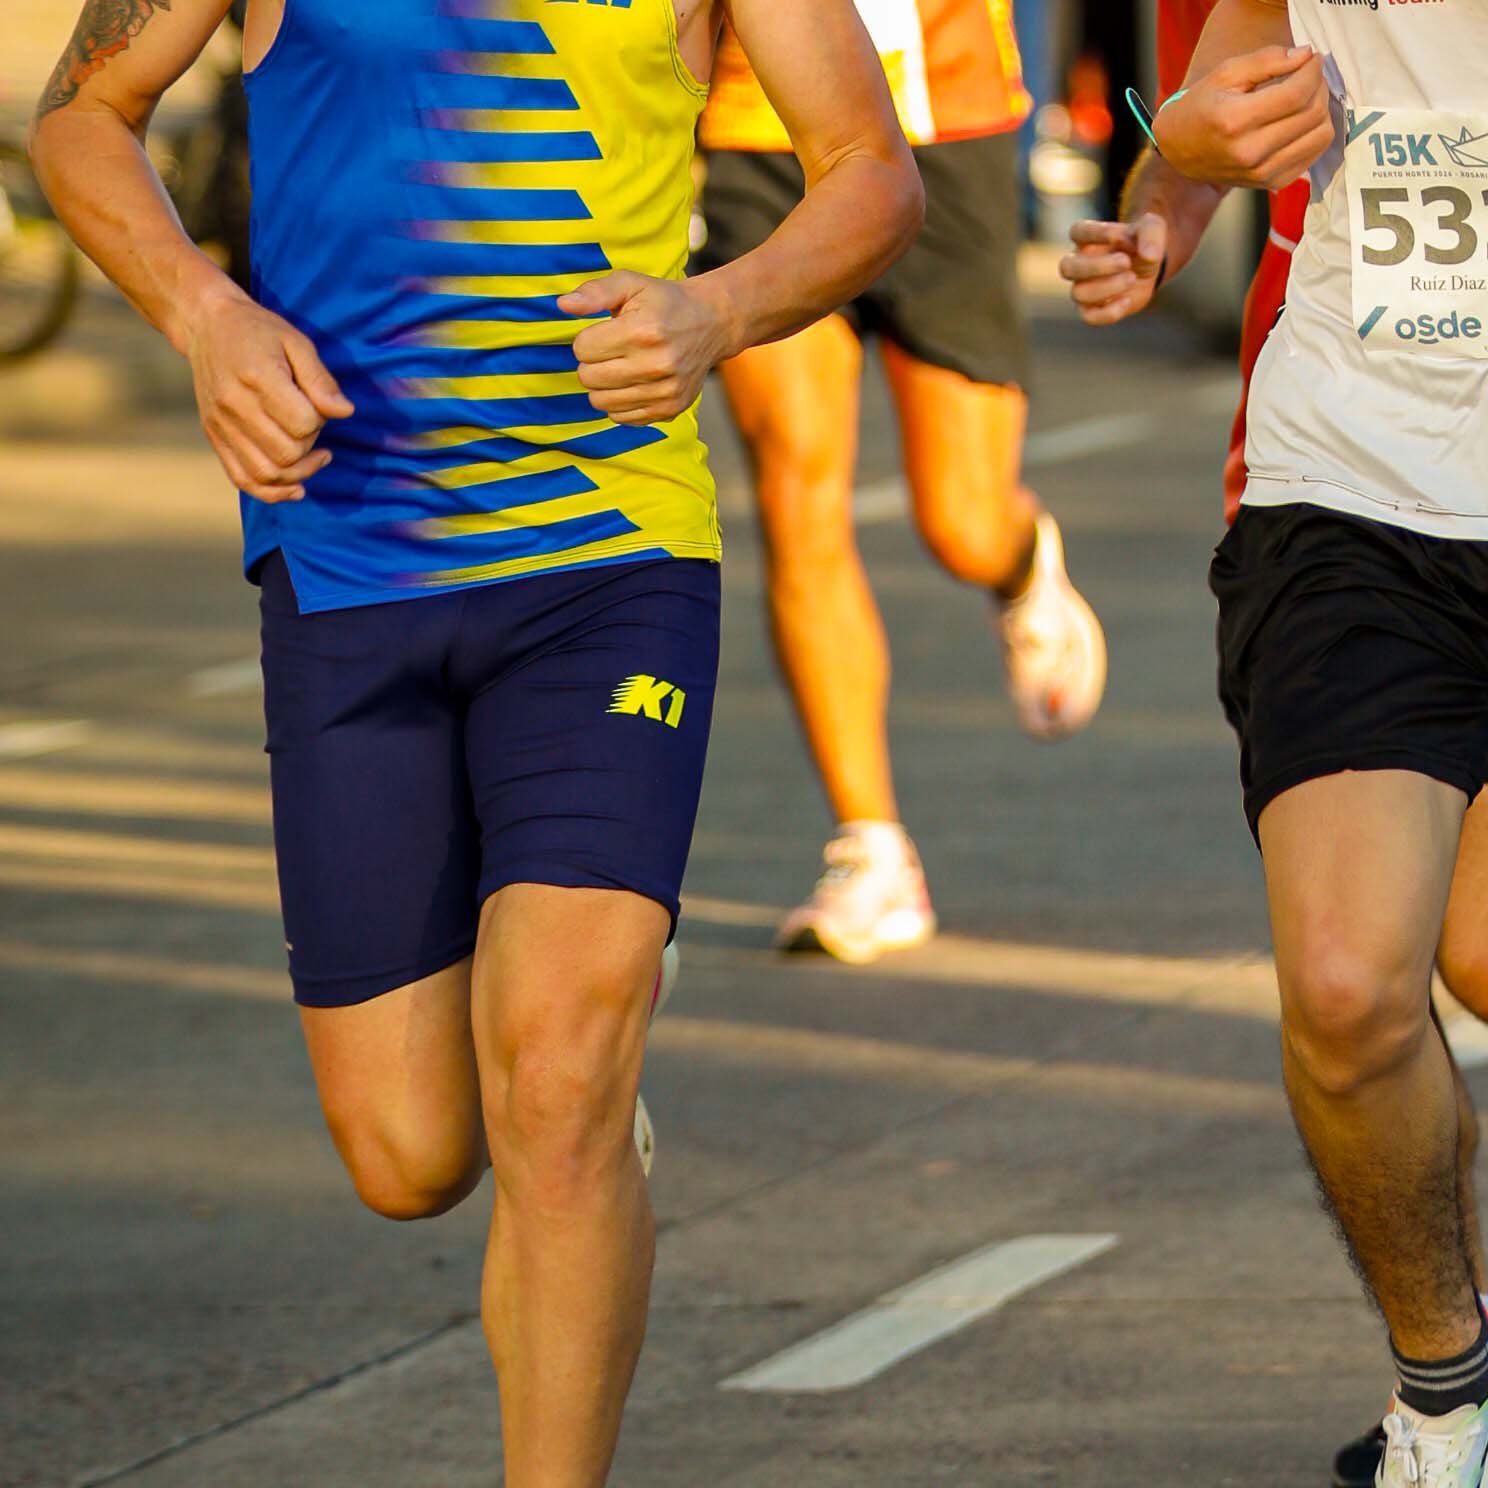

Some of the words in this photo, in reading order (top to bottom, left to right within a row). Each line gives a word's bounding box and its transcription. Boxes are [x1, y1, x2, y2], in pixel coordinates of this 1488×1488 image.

[1368, 132, 1439, 167] 15K
[1395, 310, 1481, 343] osde
[605, 674, 686, 729] K1
